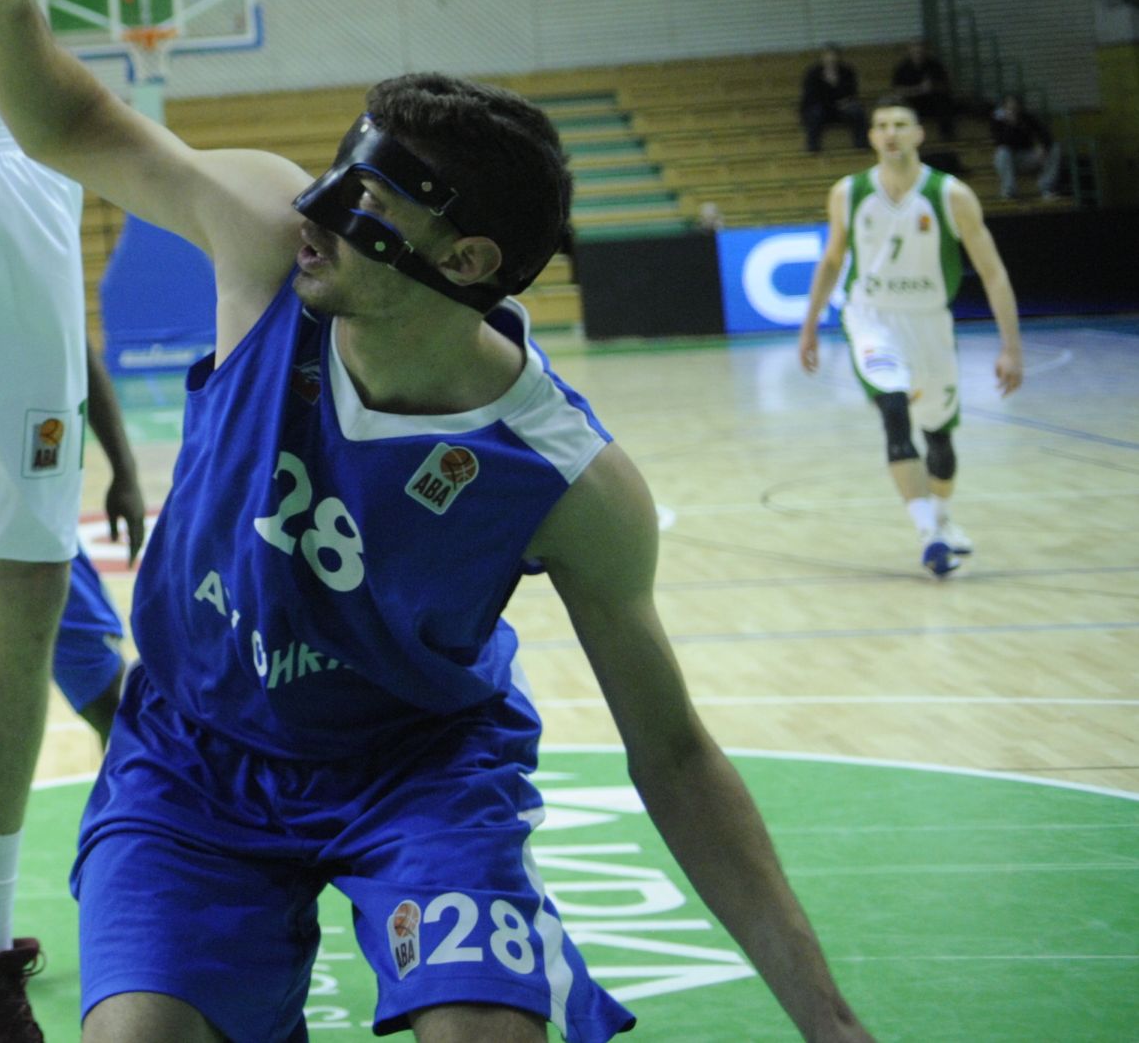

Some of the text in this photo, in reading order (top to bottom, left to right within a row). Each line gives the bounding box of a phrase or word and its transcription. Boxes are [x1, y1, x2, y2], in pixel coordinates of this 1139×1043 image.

[890, 235, 904, 262] 7
[412, 471, 452, 508] ABA
[254, 451, 365, 592] 28
[423, 891, 535, 975] 28
[394, 939, 417, 972] ABA
